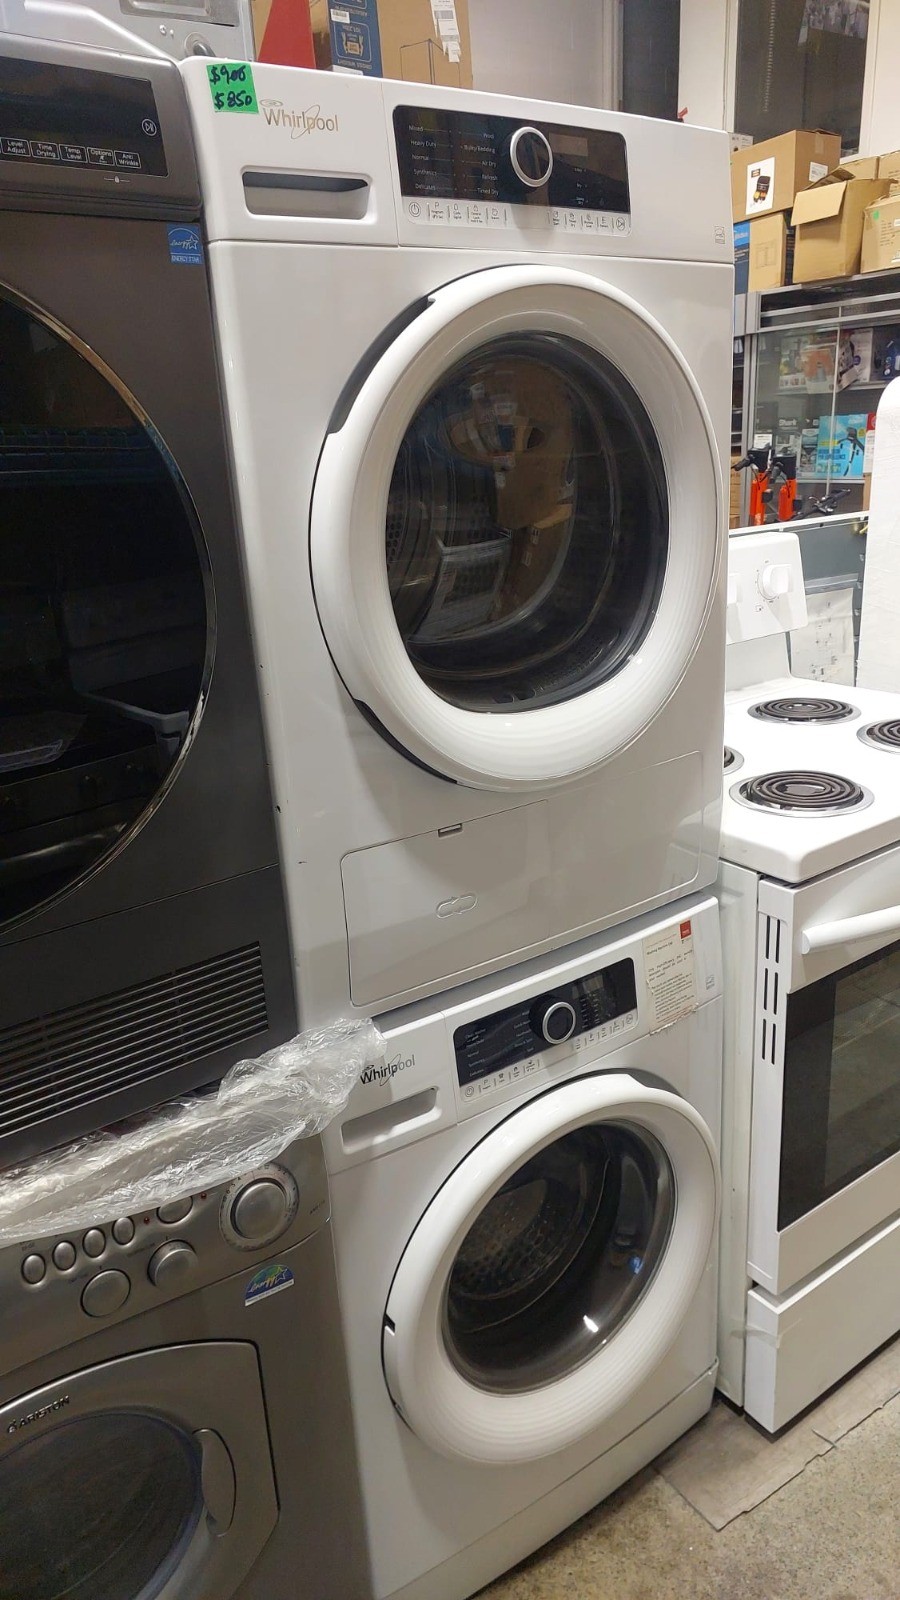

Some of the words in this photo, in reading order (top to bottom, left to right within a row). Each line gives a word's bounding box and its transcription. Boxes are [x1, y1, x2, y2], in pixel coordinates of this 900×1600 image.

[214, 90, 252, 109] $850
[263, 105, 339, 135] Whirlpool
[37, 149, 56, 158] Drying
[90, 149, 112, 157] Options
[360, 1053, 415, 1085] Whirlpool
[19, 1395, 70, 1428] ARISTON
